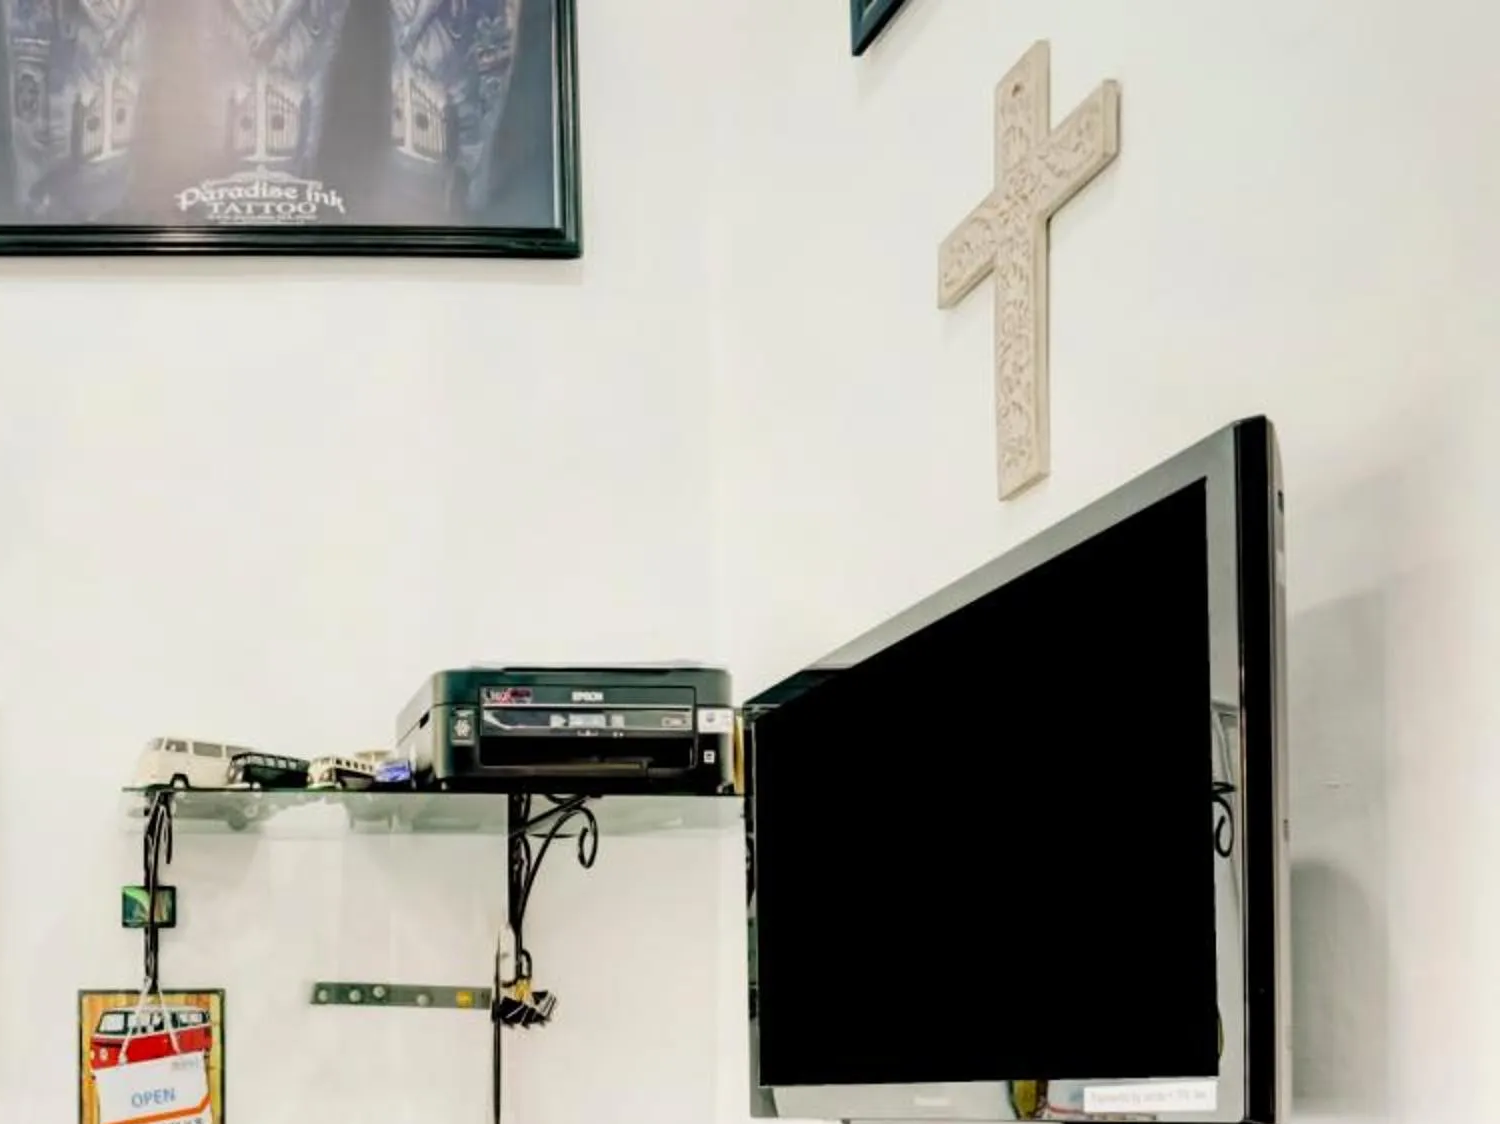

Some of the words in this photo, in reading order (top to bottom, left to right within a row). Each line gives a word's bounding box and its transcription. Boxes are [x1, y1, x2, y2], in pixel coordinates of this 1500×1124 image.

[175, 180, 298, 211] Paradise
[207, 202, 318, 214] TATTOO
[572, 691, 604, 701] EPSON
[131, 1087, 177, 1109] OPEN
